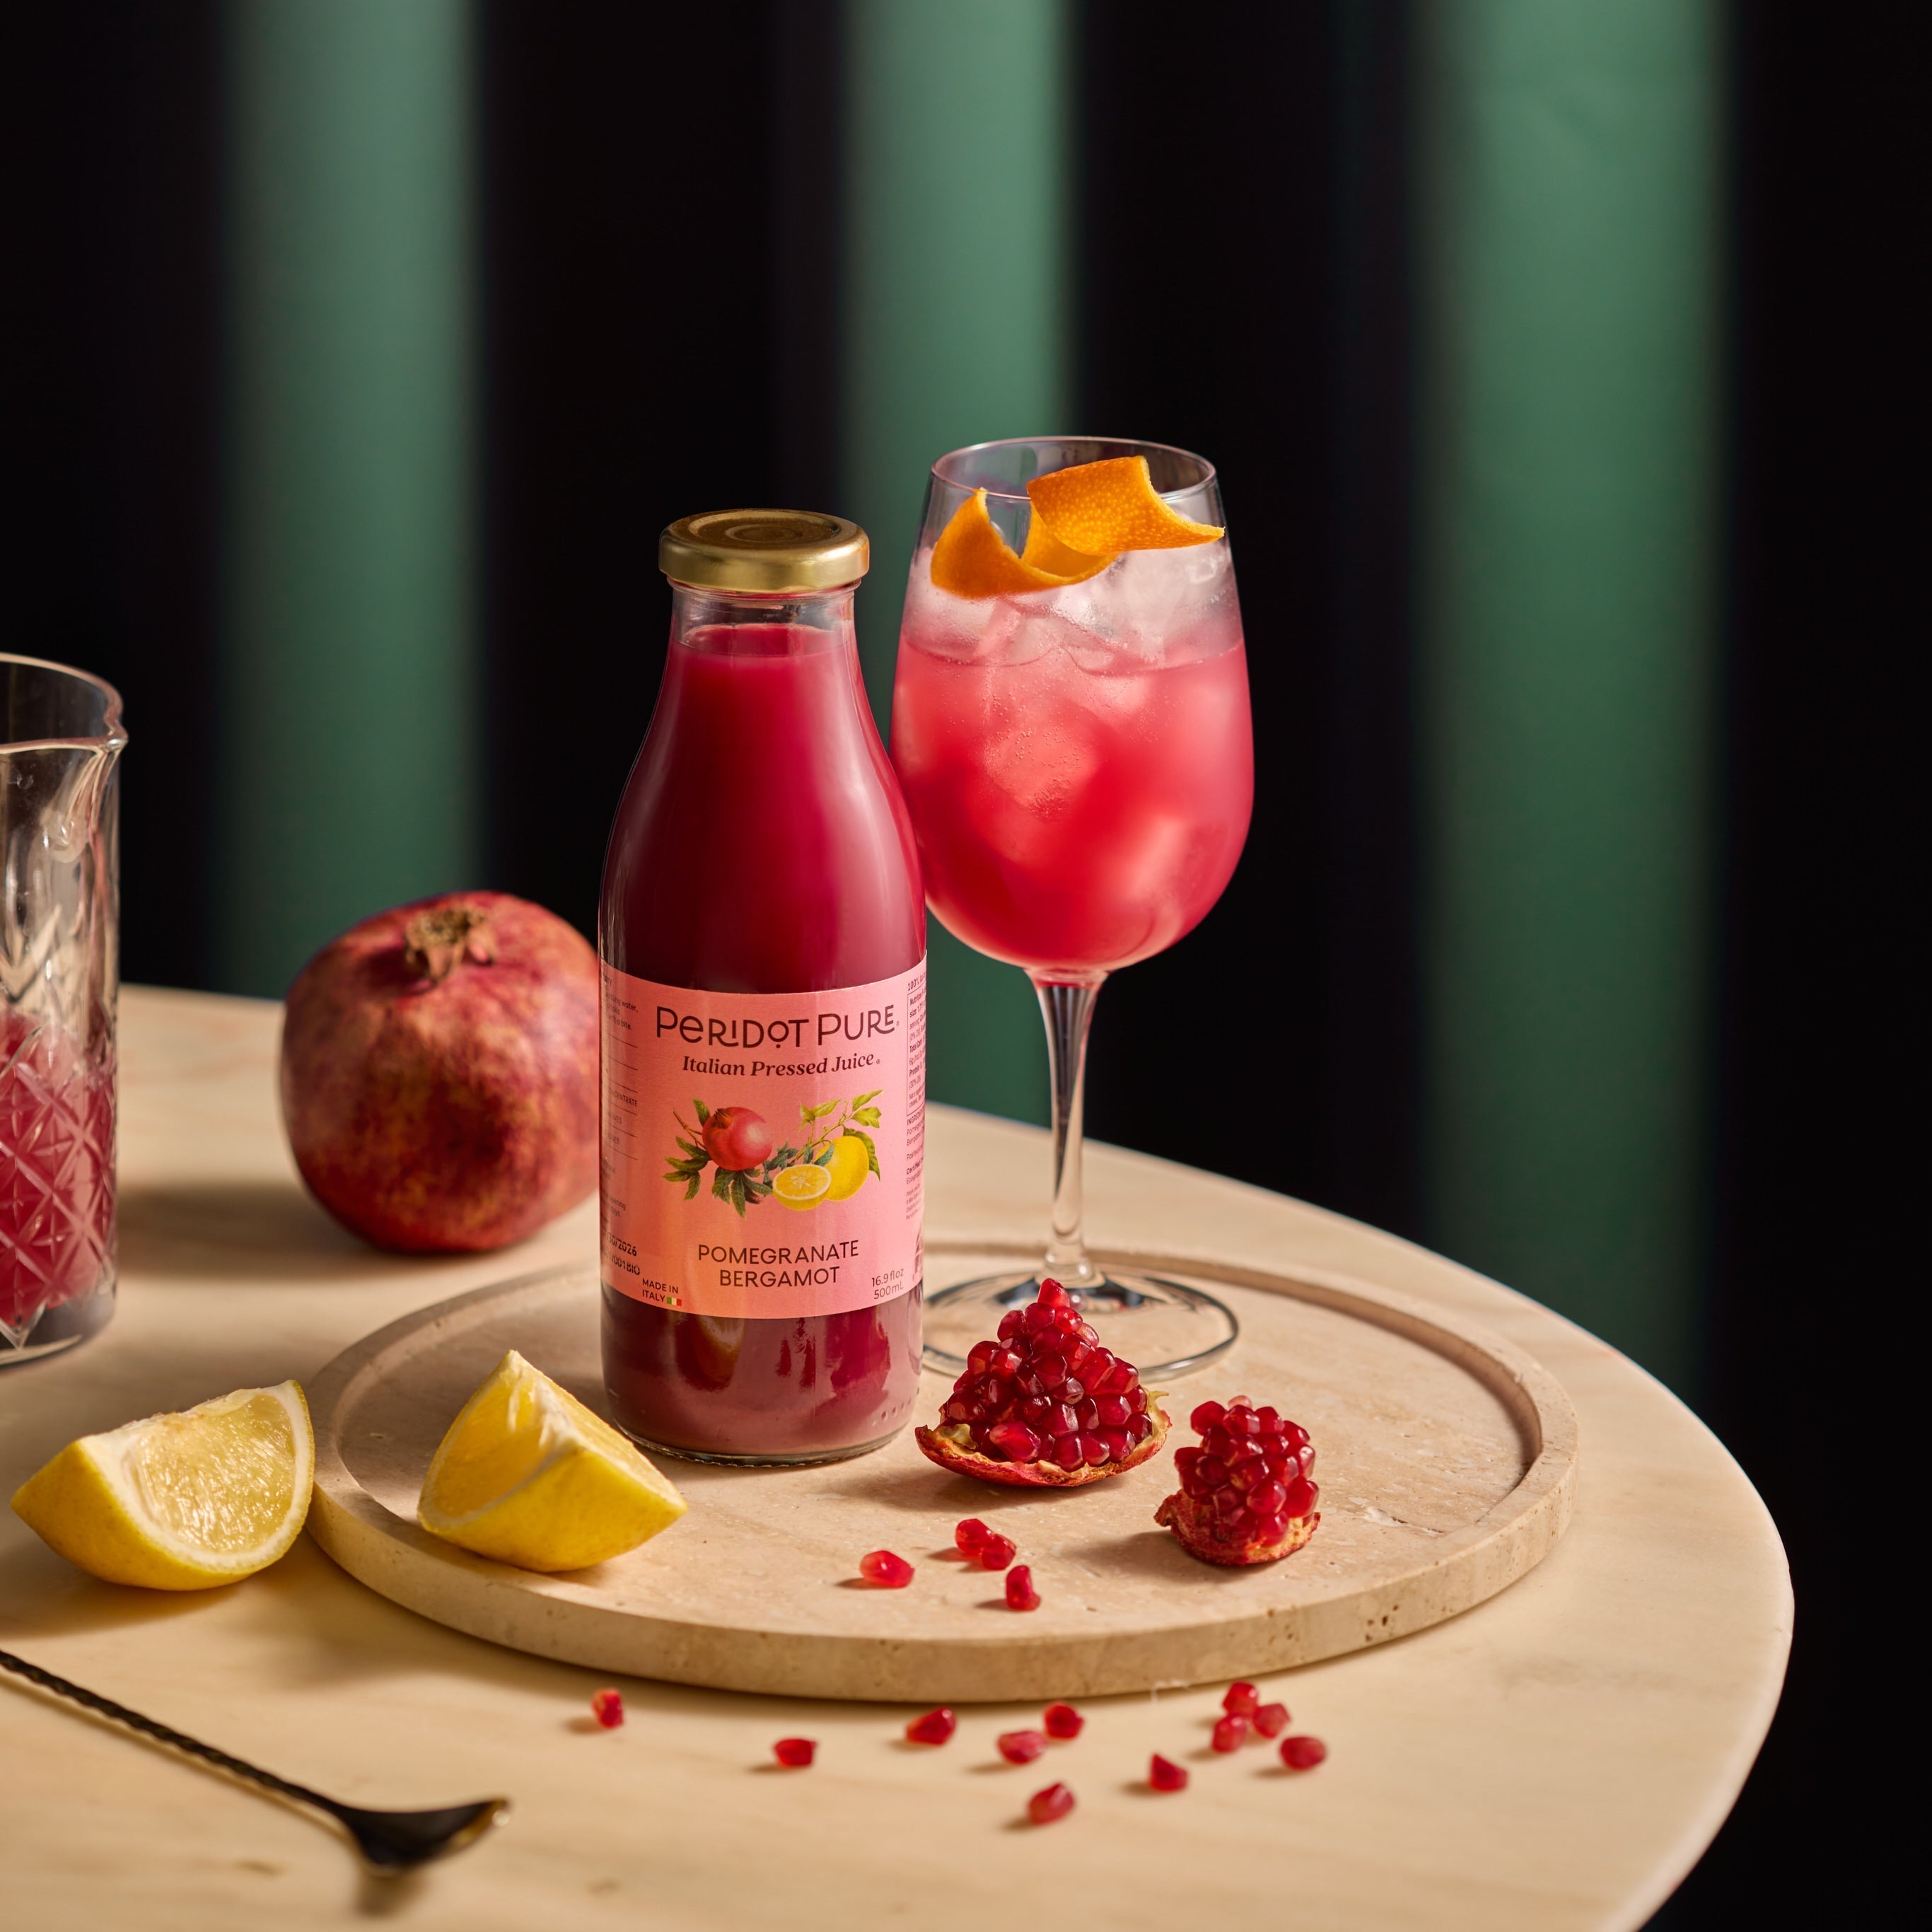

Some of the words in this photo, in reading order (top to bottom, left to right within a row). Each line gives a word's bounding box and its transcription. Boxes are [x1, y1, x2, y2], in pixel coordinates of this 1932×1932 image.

[682, 1056, 745, 1076] Italian
[750, 1057, 827, 1076] Pressed
[698, 1240, 859, 1264] POMEGRANATE
[720, 1266, 840, 1287] BERGAMOT
[871, 1274, 888, 1287] 16.9
[642, 1278, 667, 1292] MADE
[669, 1286, 678, 1294] IN
[642, 1290, 665, 1302] ITALY
